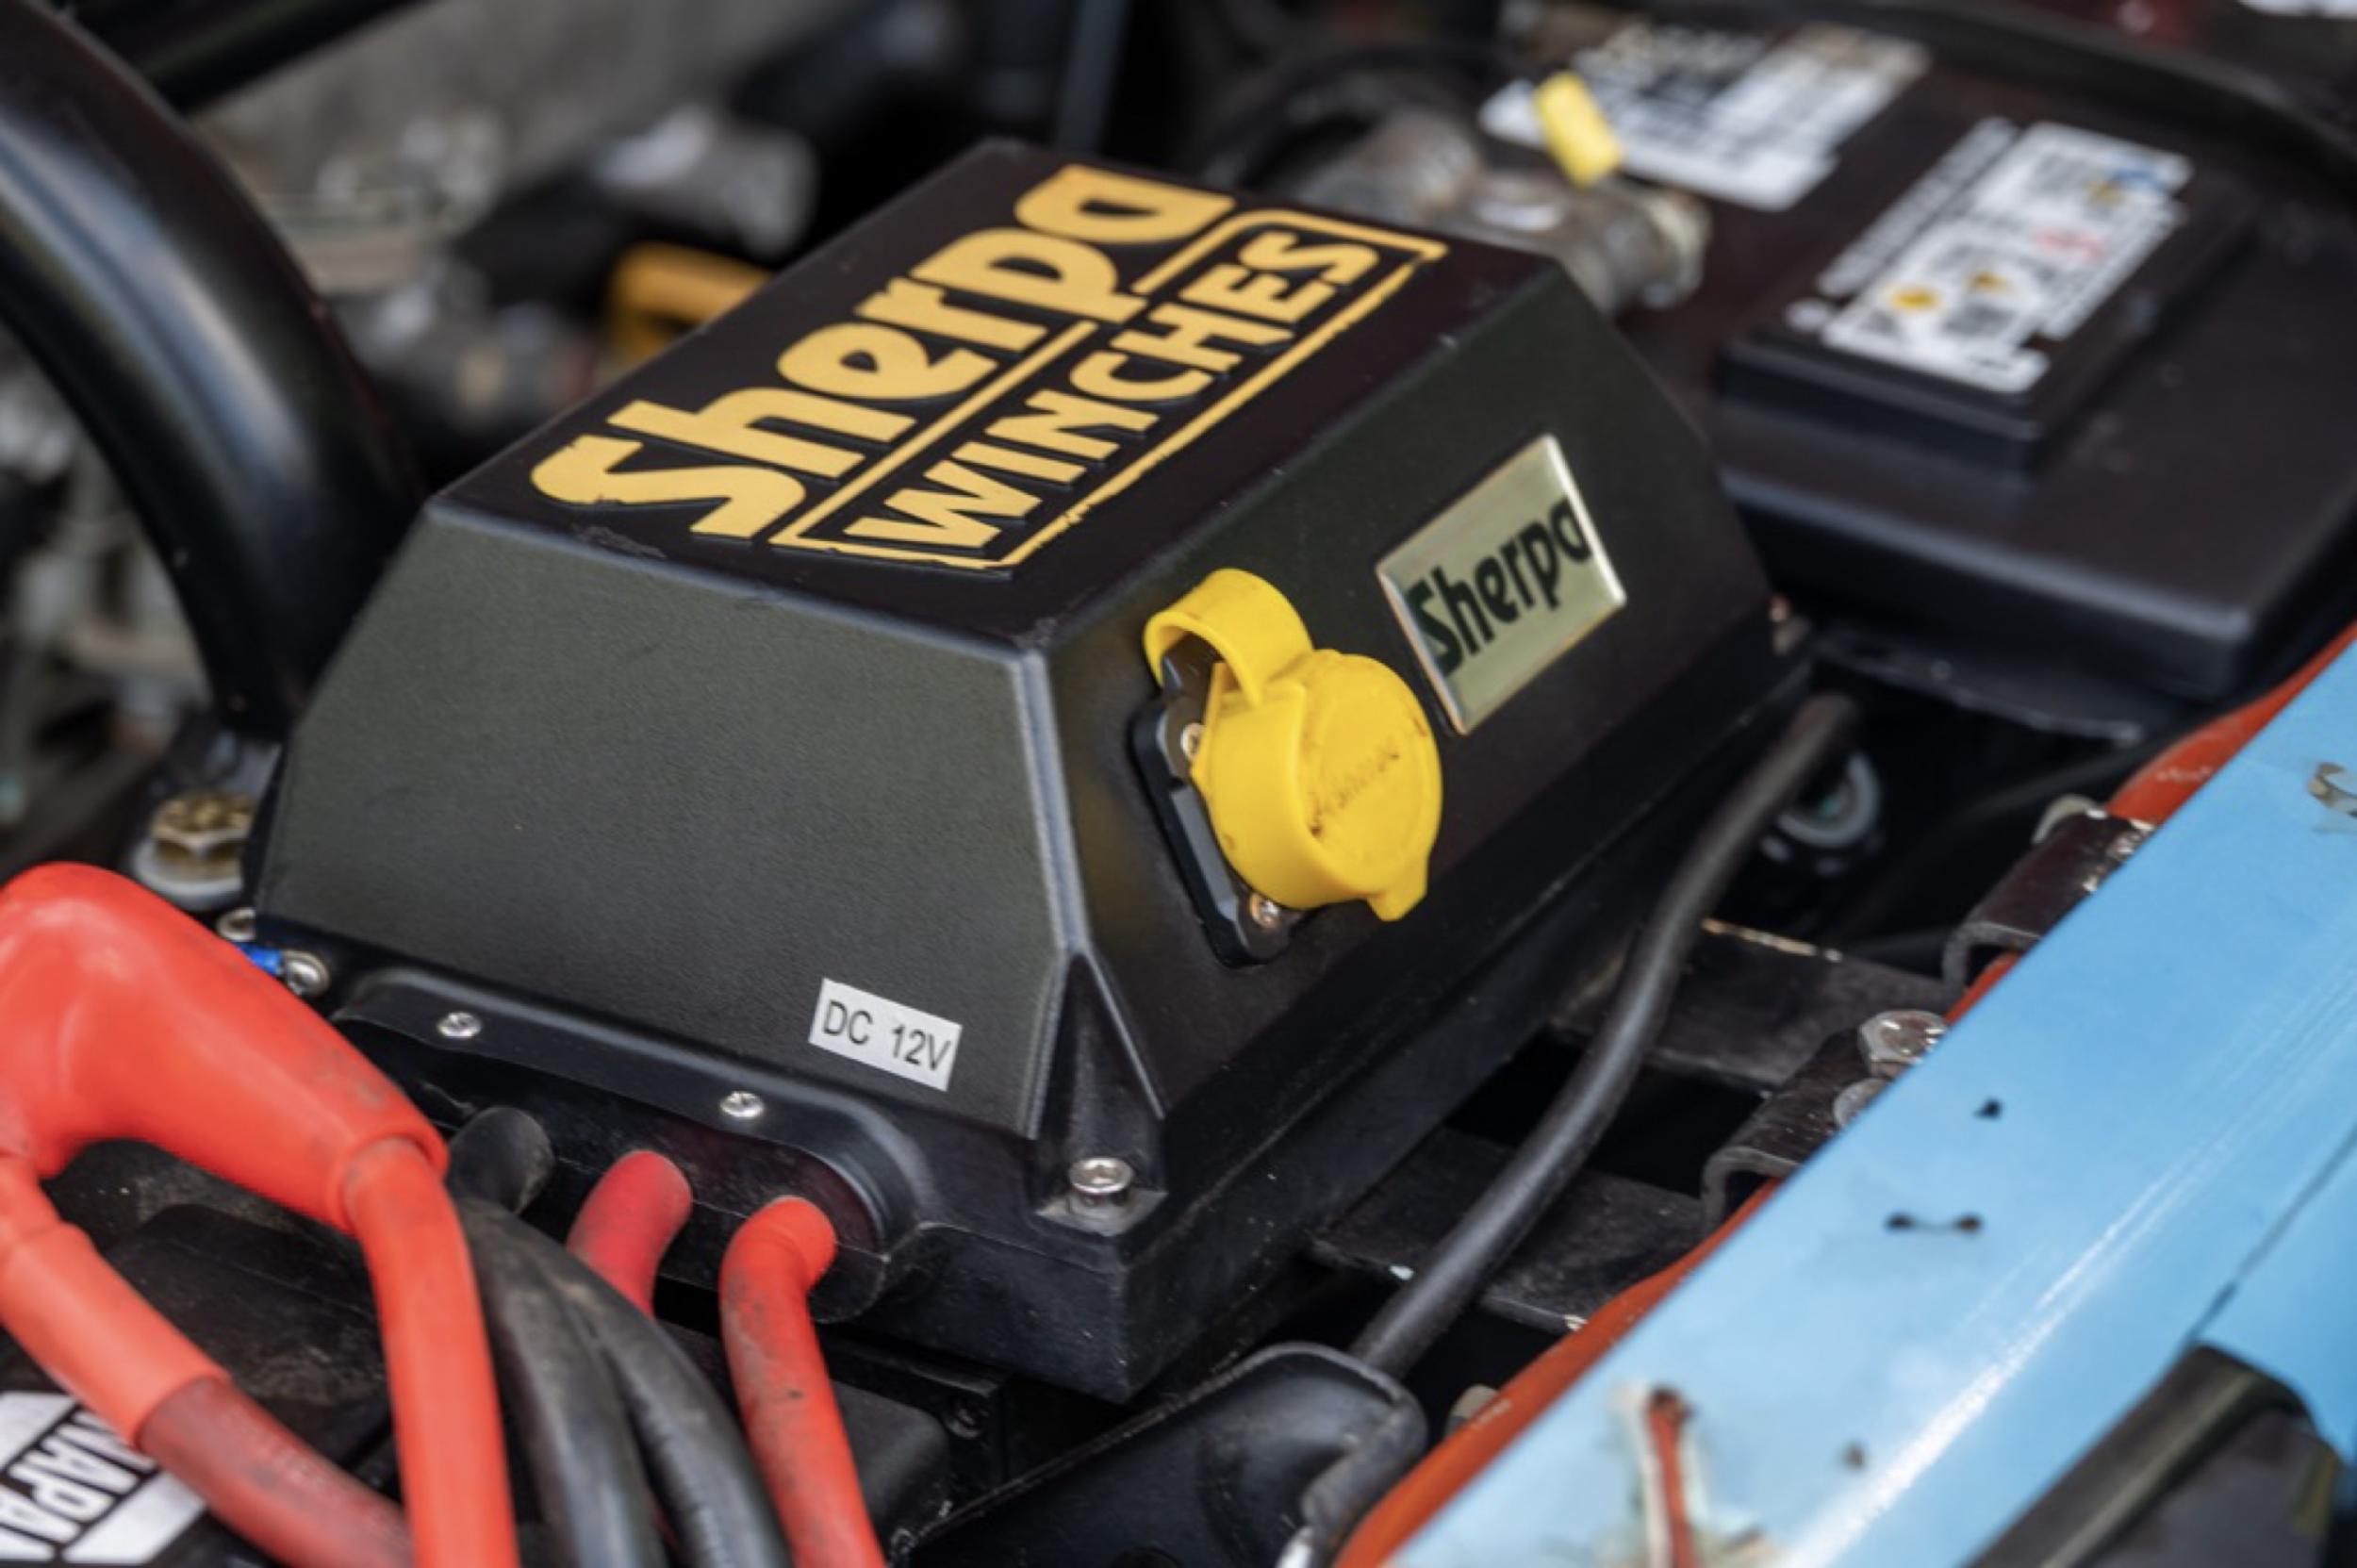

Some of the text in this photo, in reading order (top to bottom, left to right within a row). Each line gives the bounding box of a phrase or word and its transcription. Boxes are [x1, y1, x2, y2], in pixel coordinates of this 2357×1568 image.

[531, 164, 1236, 540] Sherpa
[843, 231, 1378, 549] WINCHES
[1403, 496, 1594, 678] Sherpa
[823, 999, 951, 1071] DC 12V
